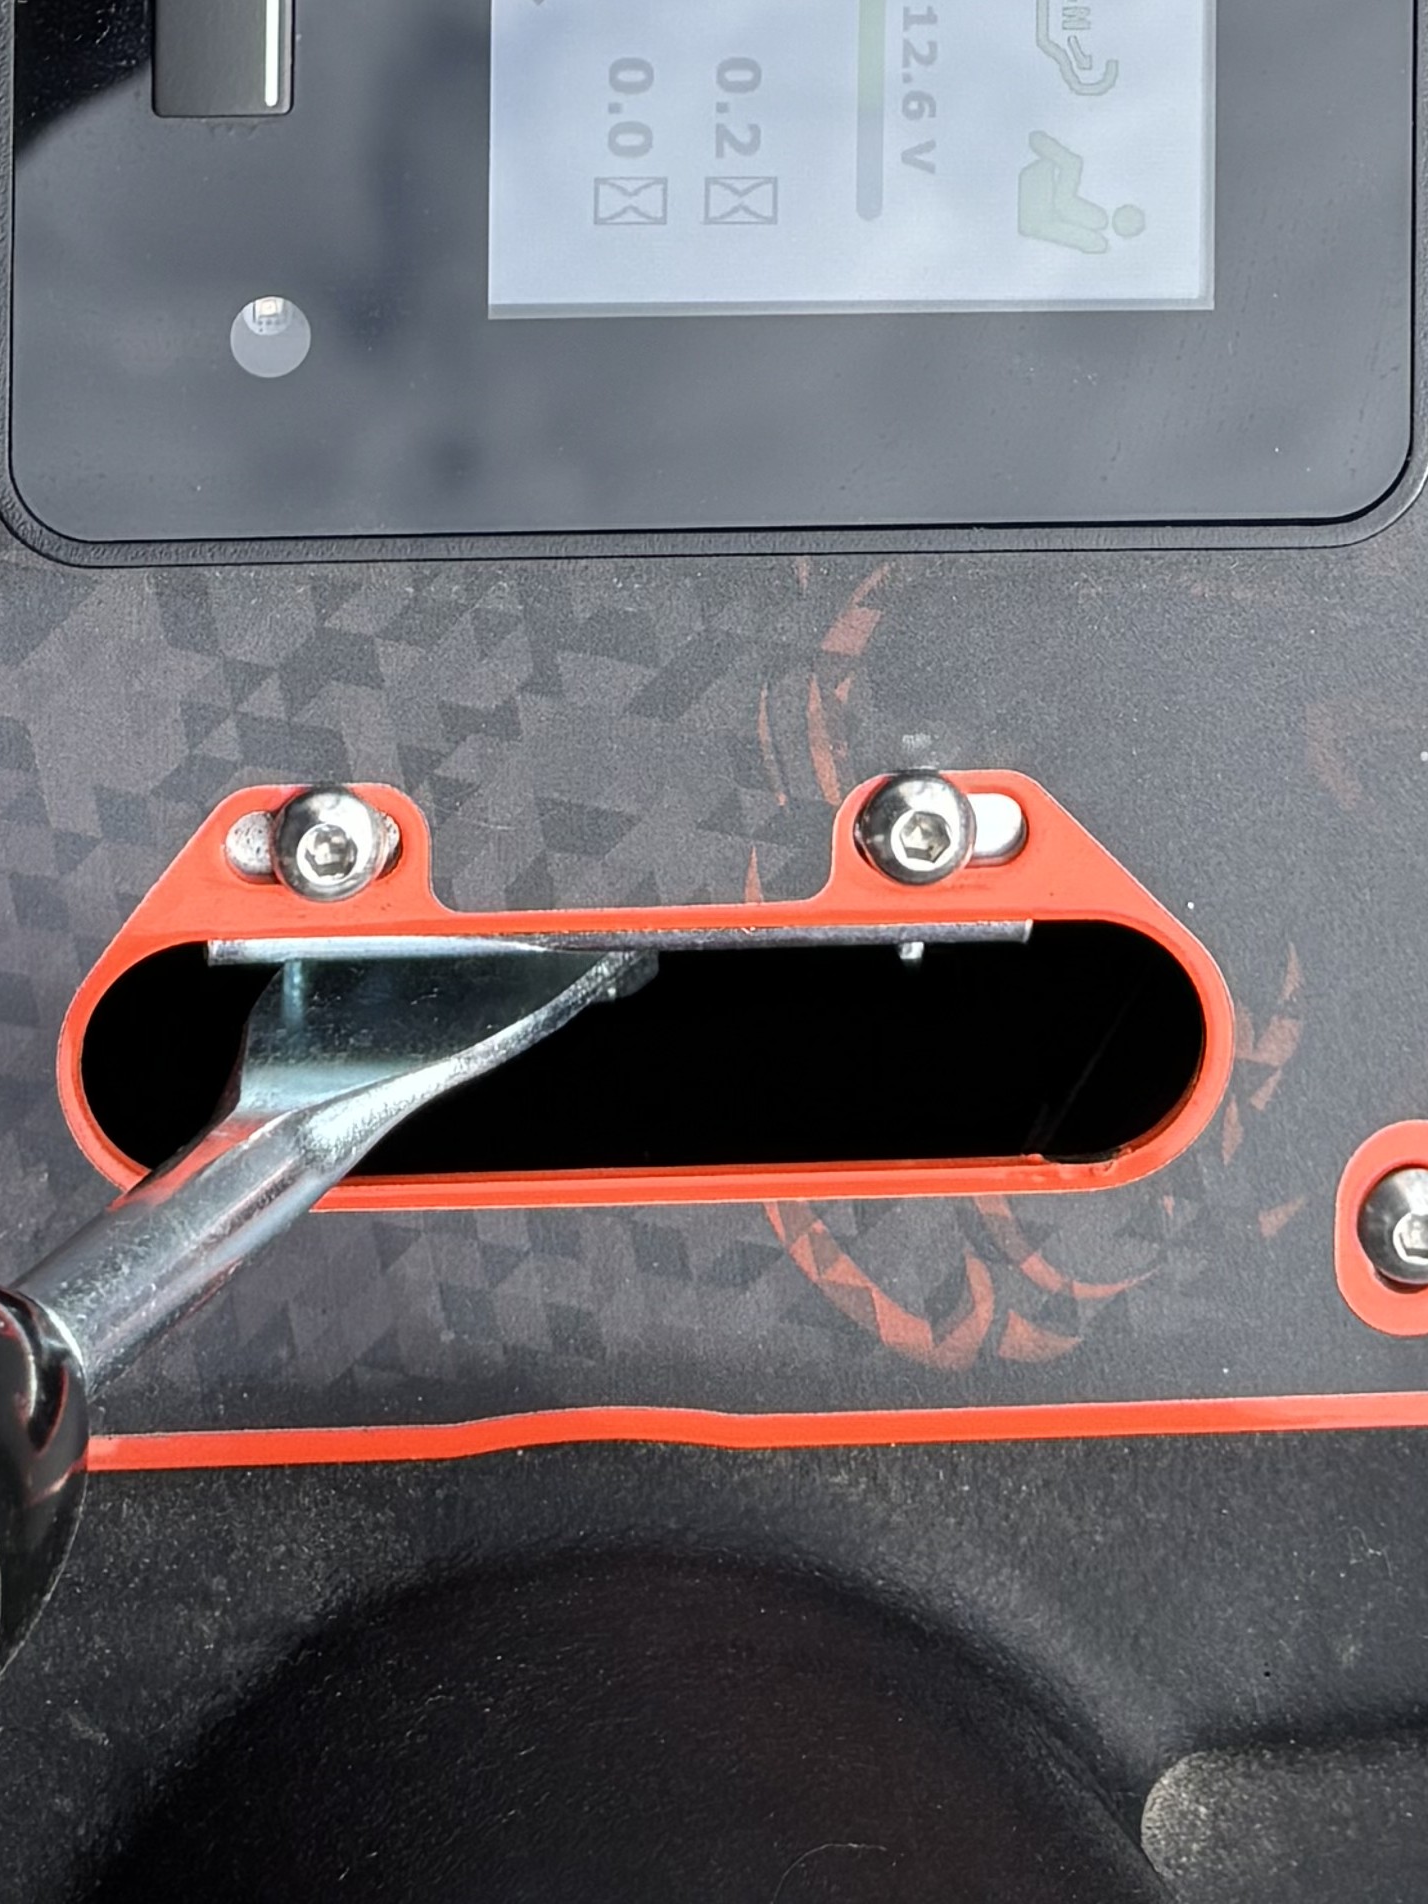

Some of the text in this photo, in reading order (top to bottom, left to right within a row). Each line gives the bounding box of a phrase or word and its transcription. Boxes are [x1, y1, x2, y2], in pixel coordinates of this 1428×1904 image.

[607, 56, 655, 159] 0.0
[714, 56, 762, 159] 0.2
[901, 5, 939, 175] 12.6 V
